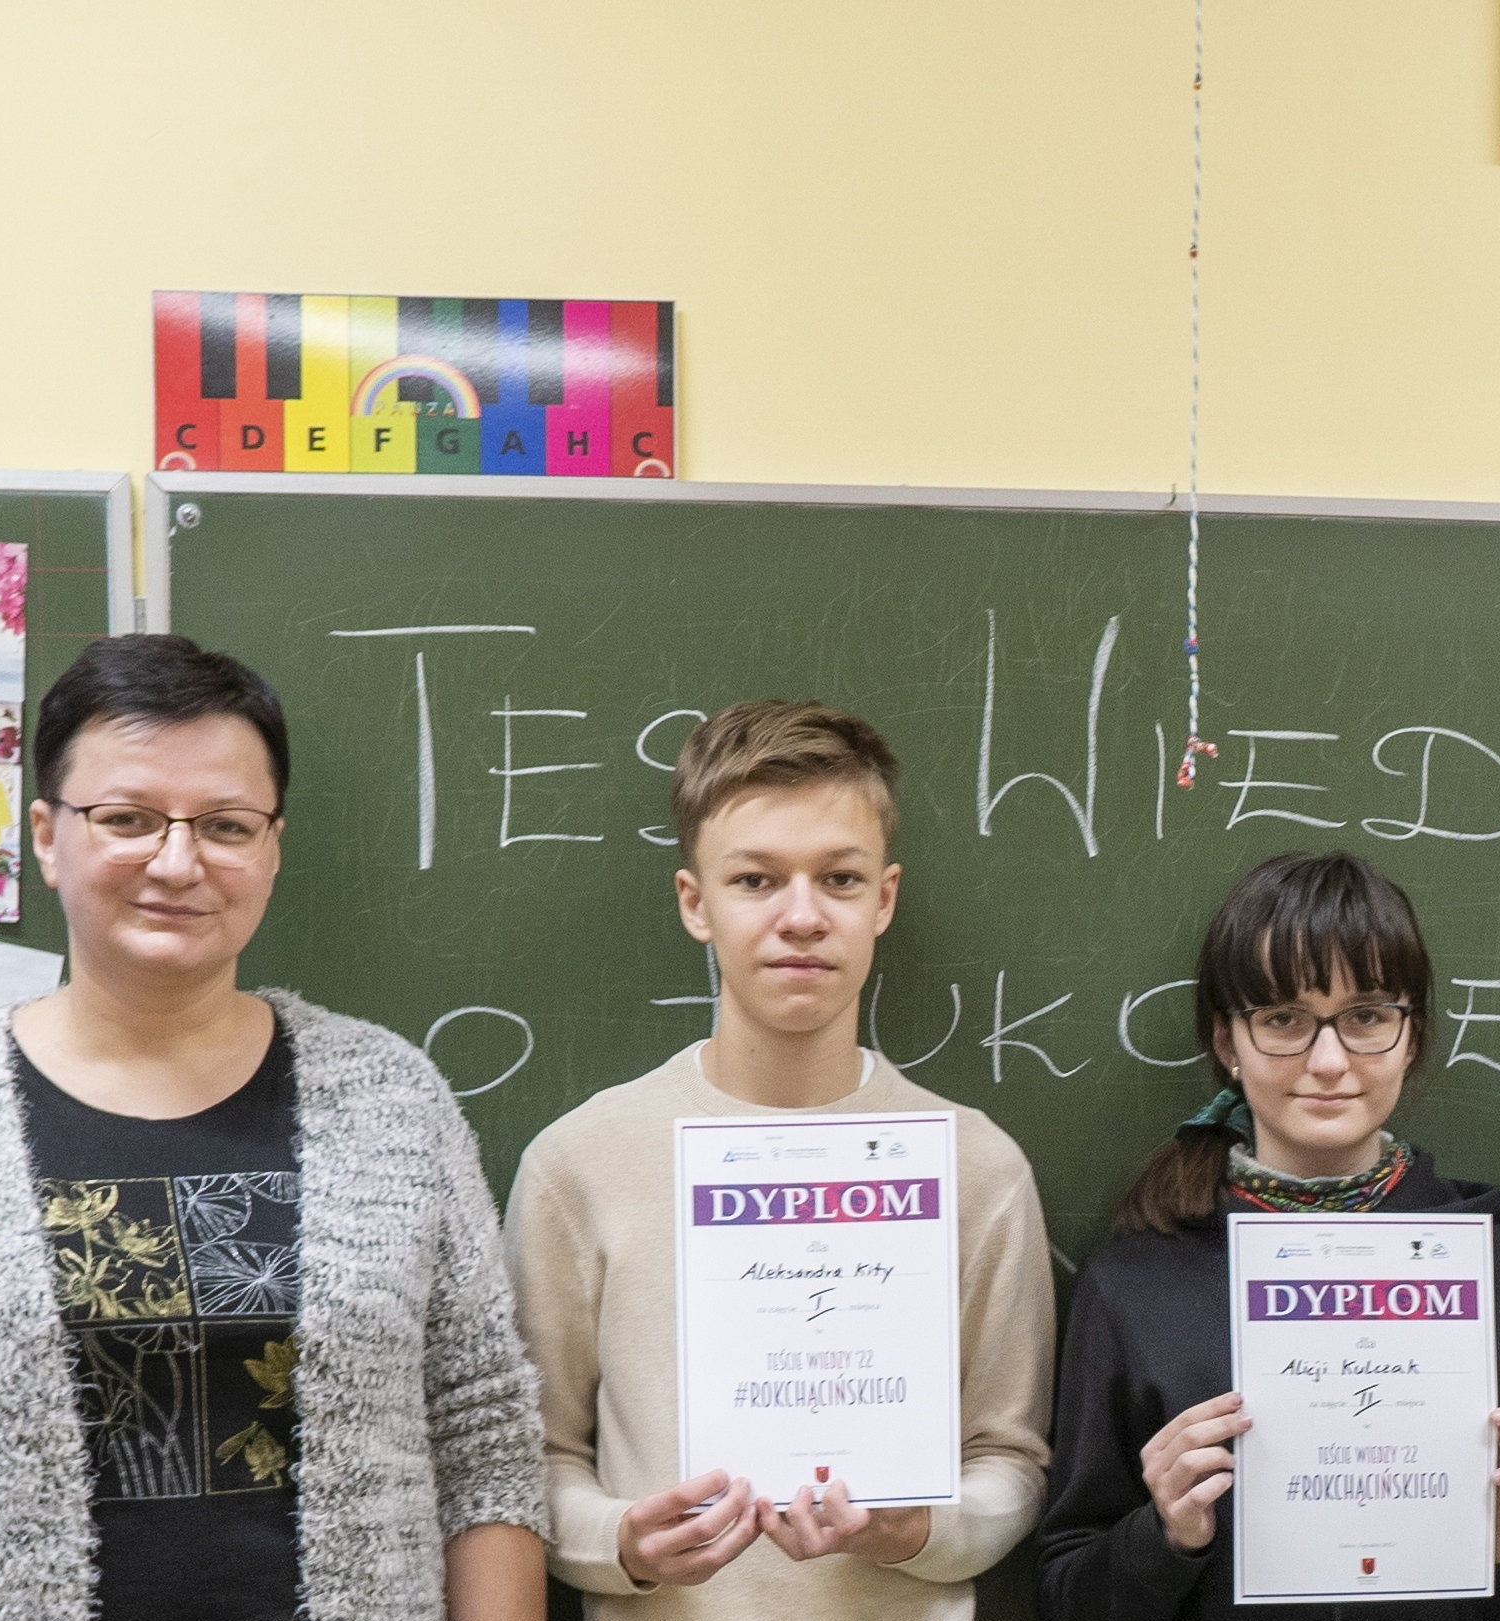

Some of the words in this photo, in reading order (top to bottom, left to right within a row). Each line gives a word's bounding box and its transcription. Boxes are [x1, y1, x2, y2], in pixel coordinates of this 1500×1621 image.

[175, 424, 197, 449] C
[241, 425, 265, 449] D
[308, 427, 326, 452] E
[375, 427, 392, 452] F
[436, 429, 459, 454] G
[501, 431, 526, 456] A
[568, 431, 588, 456] H
[633, 431, 652, 457] C
[330, 622, 708, 871] TES
[708, 1183, 924, 1222] DYPLOM
[1265, 1283, 1463, 1317] DYPLOM
